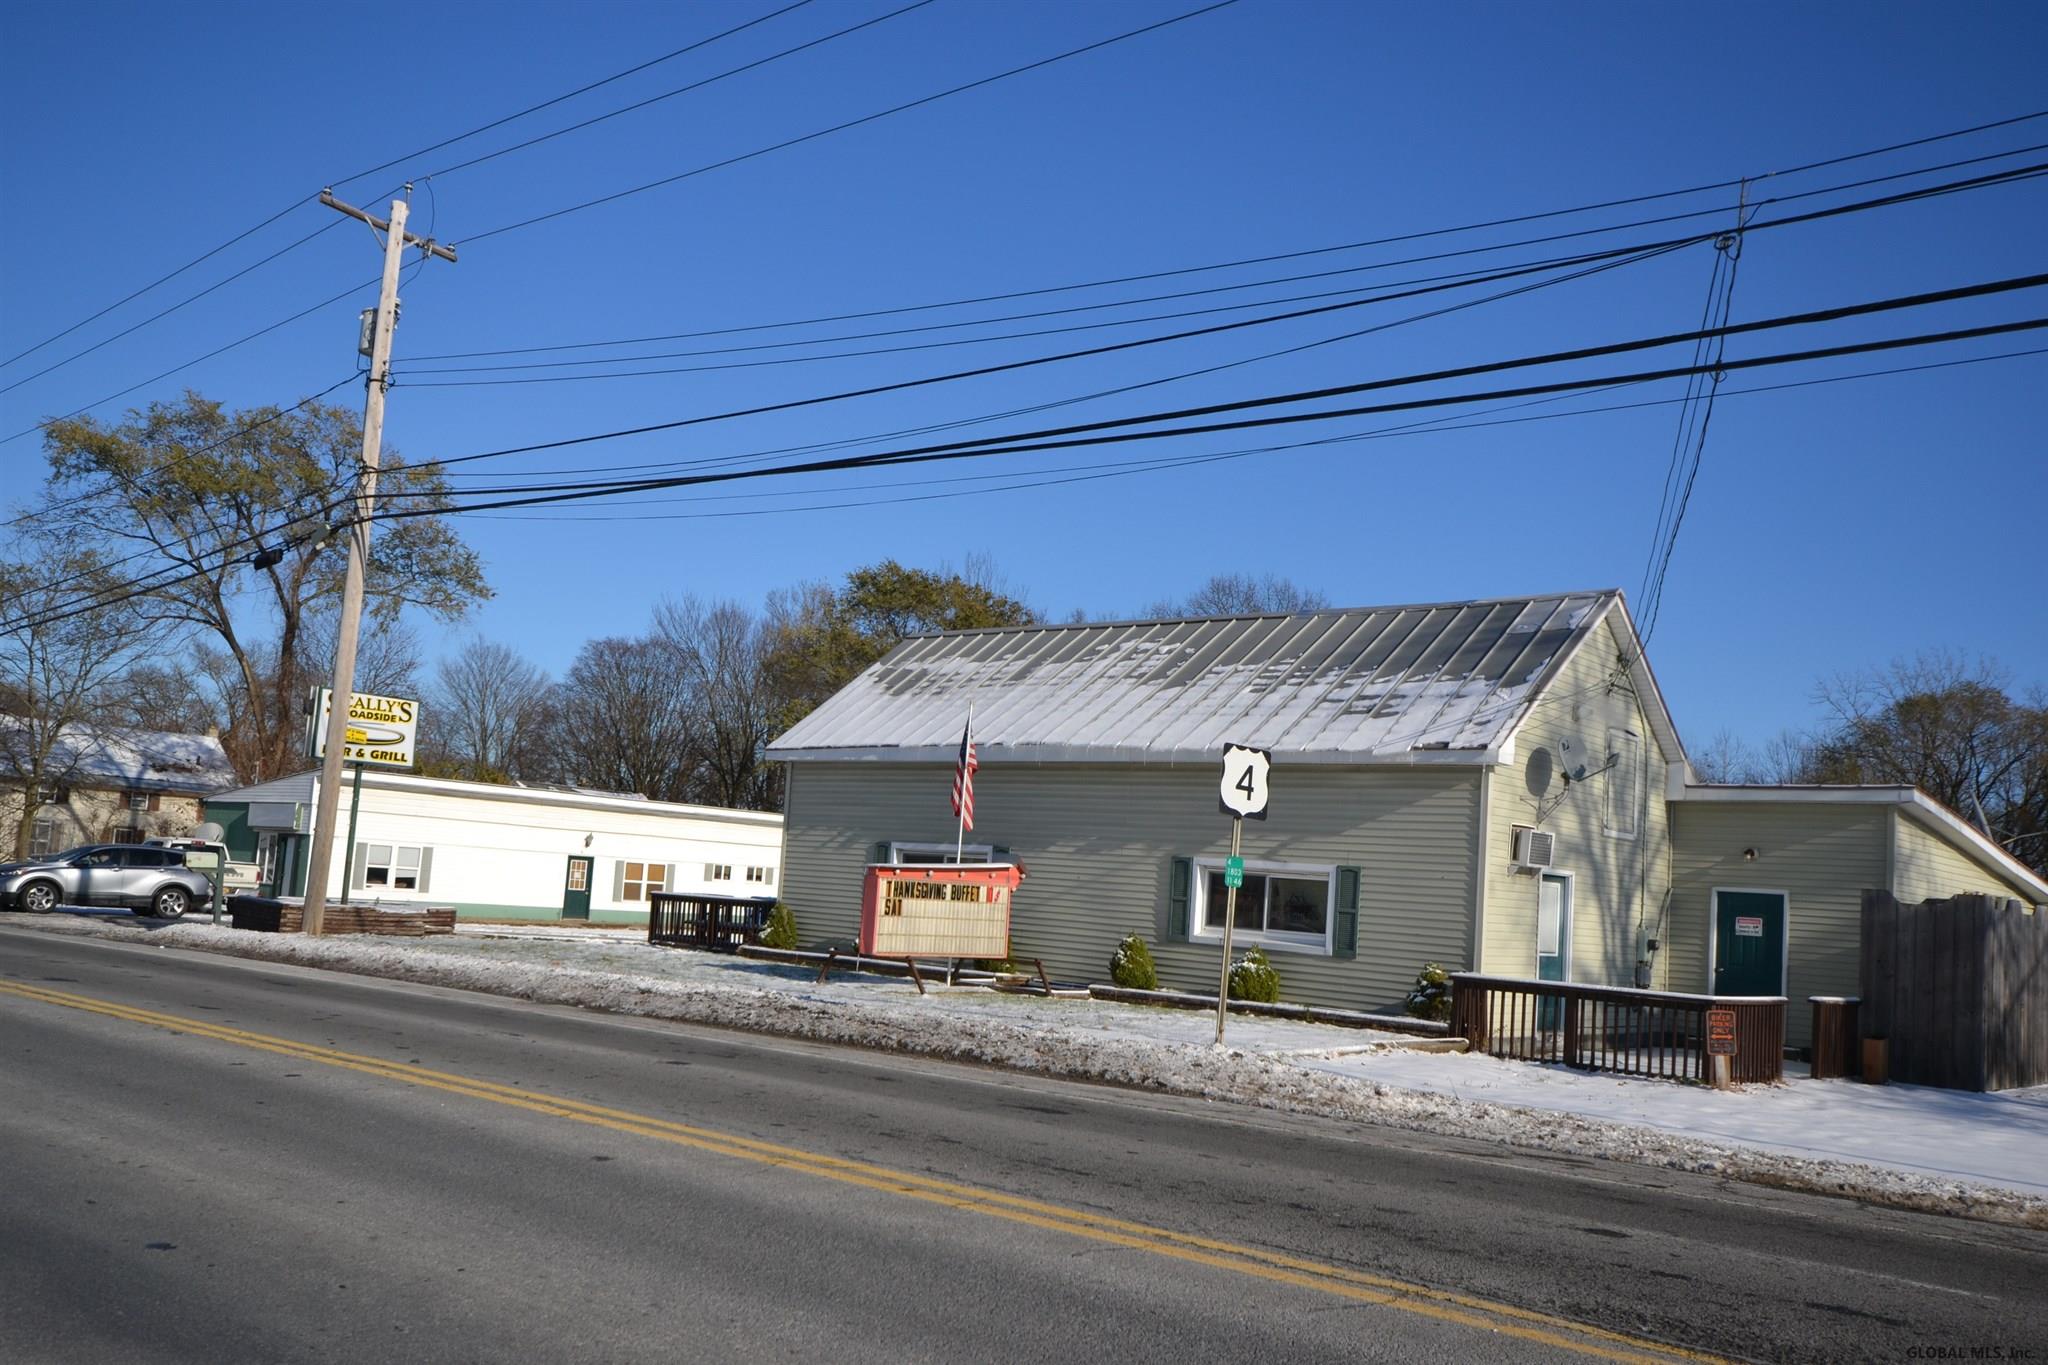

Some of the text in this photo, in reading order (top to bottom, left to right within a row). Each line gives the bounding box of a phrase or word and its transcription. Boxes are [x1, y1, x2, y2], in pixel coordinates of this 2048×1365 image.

[356, 749, 365, 758] &
[370, 750, 407, 762] GRILL
[1235, 764, 1255, 801] 4
[887, 881, 946, 900] THANKSGIVING
[950, 884, 980, 903] BUFFET
[884, 898, 902, 916] SAT
